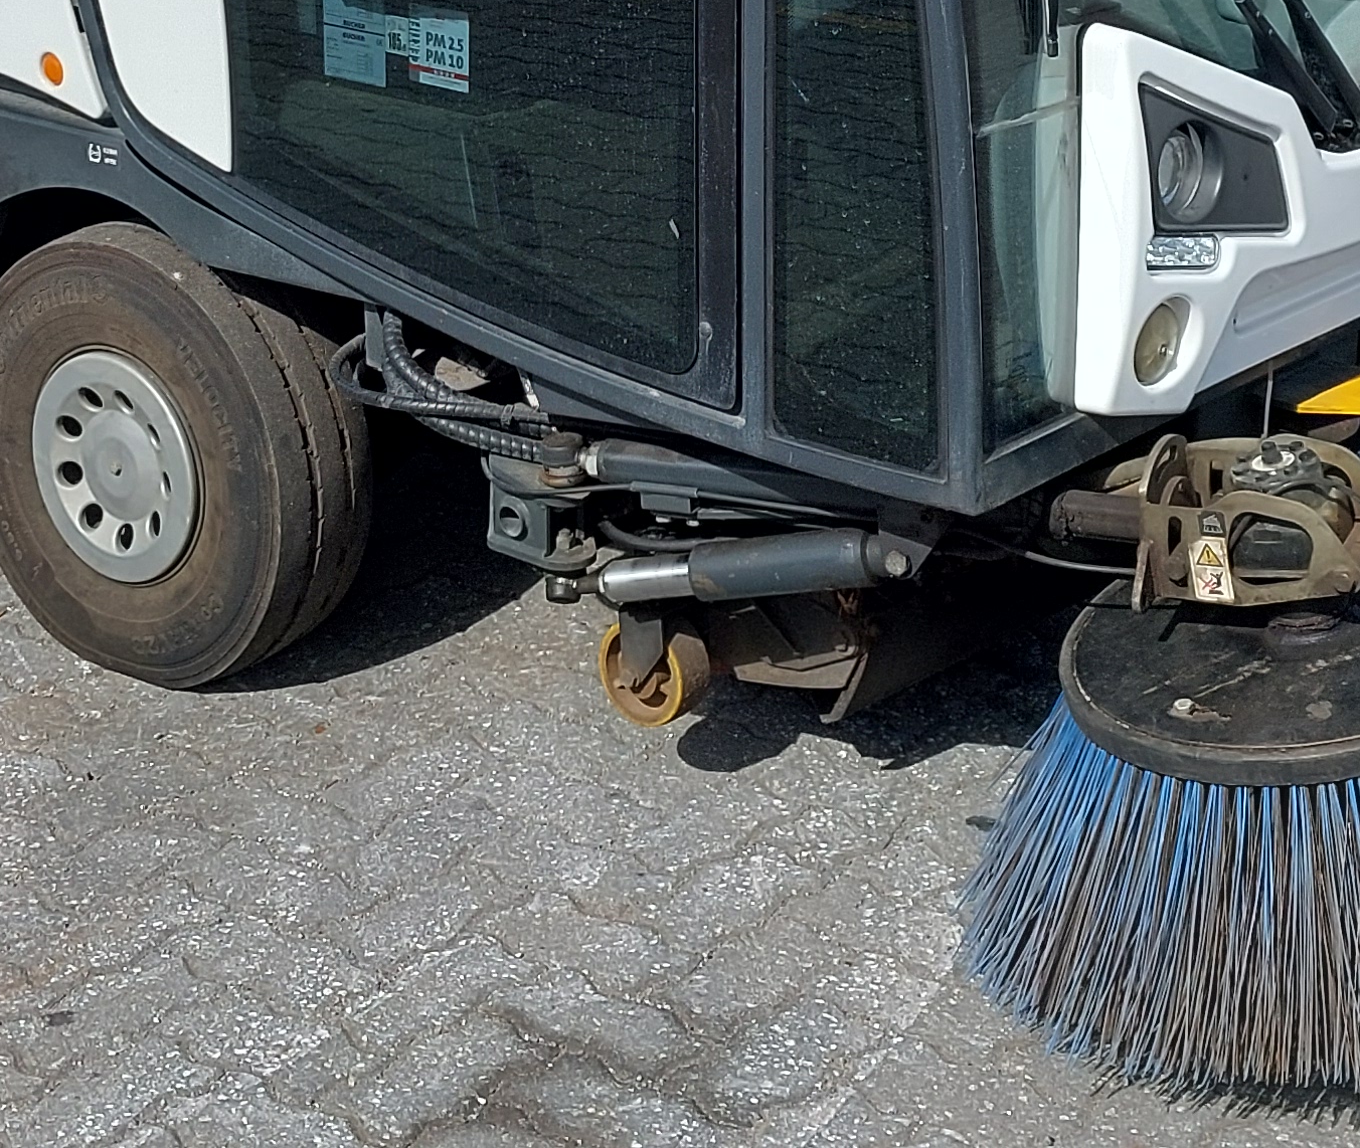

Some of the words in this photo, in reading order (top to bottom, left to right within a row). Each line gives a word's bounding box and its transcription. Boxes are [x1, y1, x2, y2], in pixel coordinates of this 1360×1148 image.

[426, 31, 446, 49] PM
[426, 48, 446, 66] PM
[448, 54, 464, 69] 10
